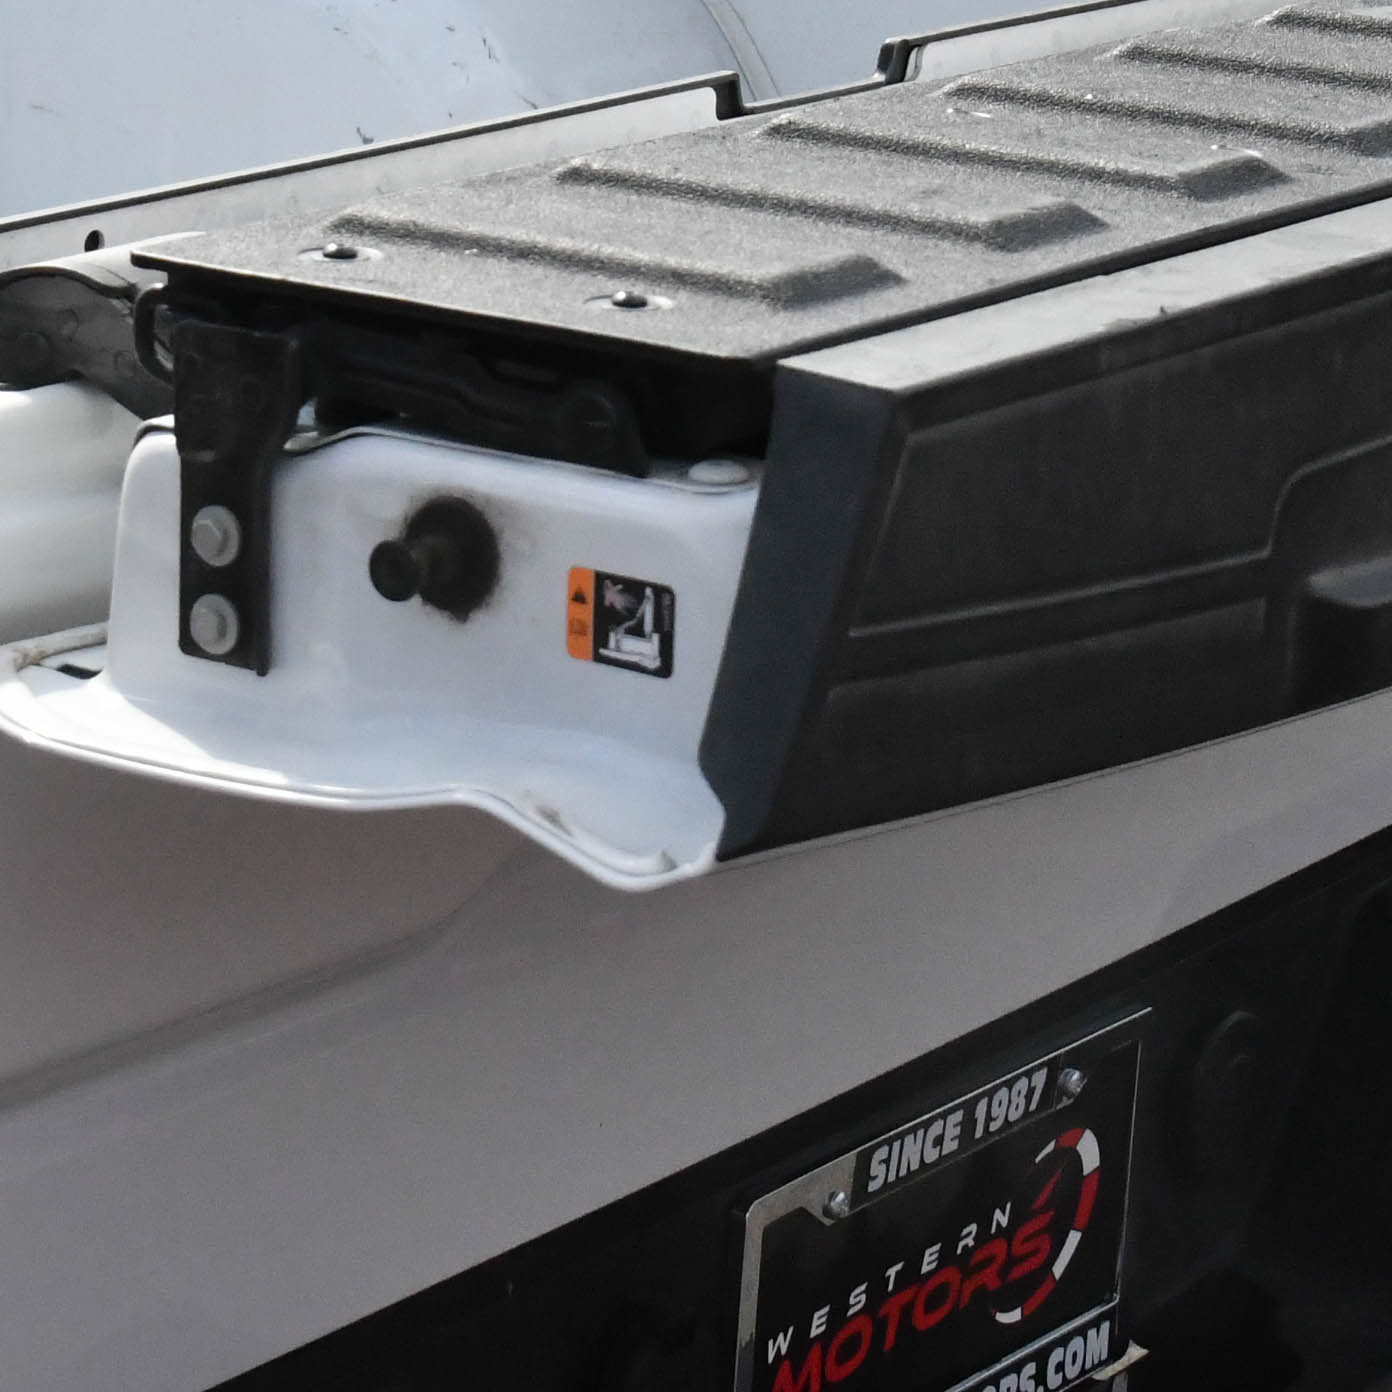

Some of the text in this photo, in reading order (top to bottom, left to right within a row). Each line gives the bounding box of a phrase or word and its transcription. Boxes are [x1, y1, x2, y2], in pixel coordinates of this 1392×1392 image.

[867, 1066, 1048, 1193] SINCE 1987
[767, 1201, 1011, 1364] WESTERN
[769, 1210, 1055, 1392] MOTORS
